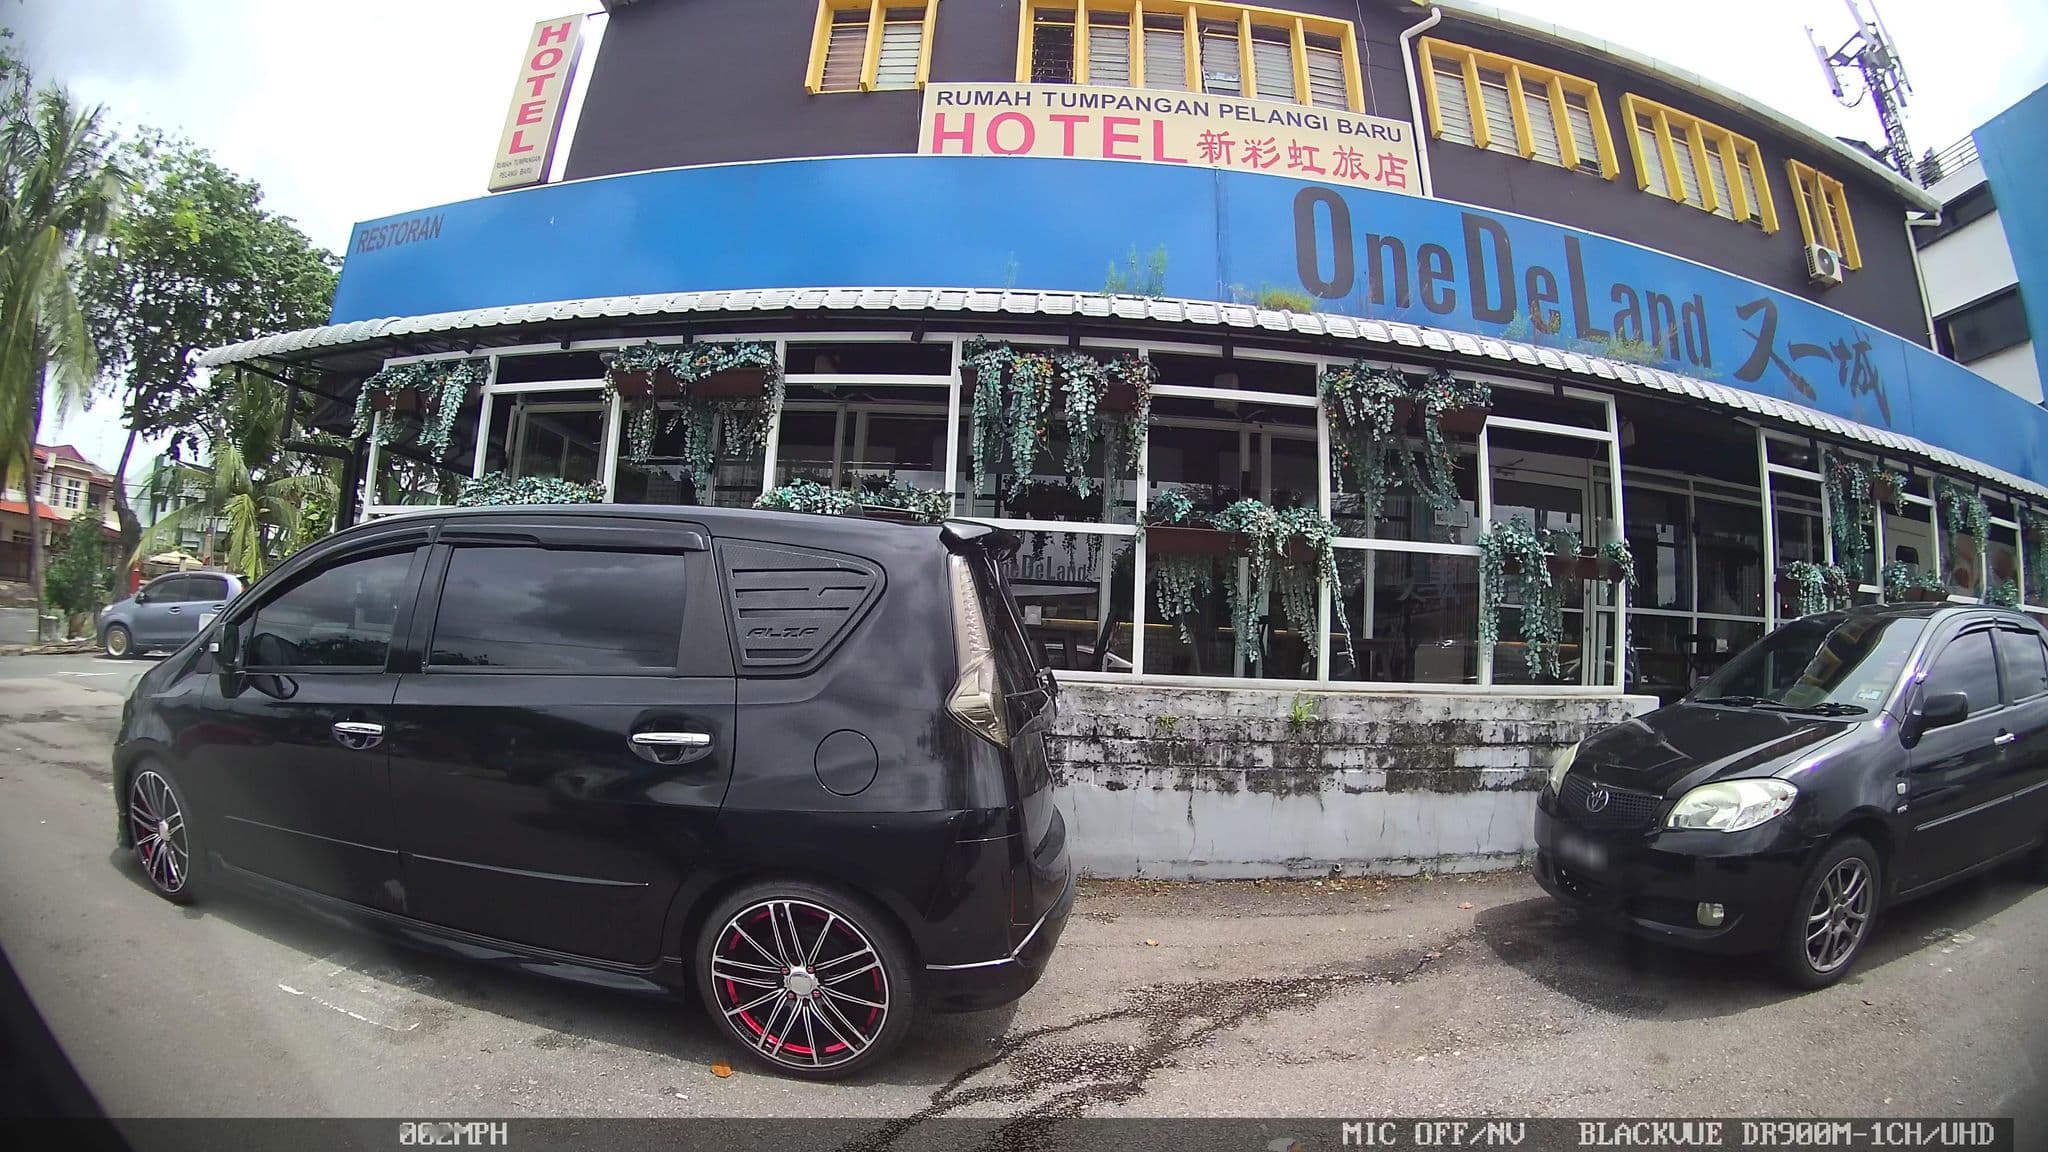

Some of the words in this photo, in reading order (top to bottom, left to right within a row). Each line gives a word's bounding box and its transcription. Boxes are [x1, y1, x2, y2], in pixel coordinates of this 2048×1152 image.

[509, 22, 571, 154] HOTEL
[936, 90, 1031, 107] RUMAH
[1042, 91, 1209, 117] TUMPANGAN
[1219, 103, 1328, 131] PELANGI
[1337, 118, 1402, 143] BARU
[932, 111, 1188, 163] HOTEL
[1196, 128, 1408, 189] 新彩虹旅店
[356, 213, 445, 254] RESTORAN
[1735, 297, 1891, 428] 又一城
